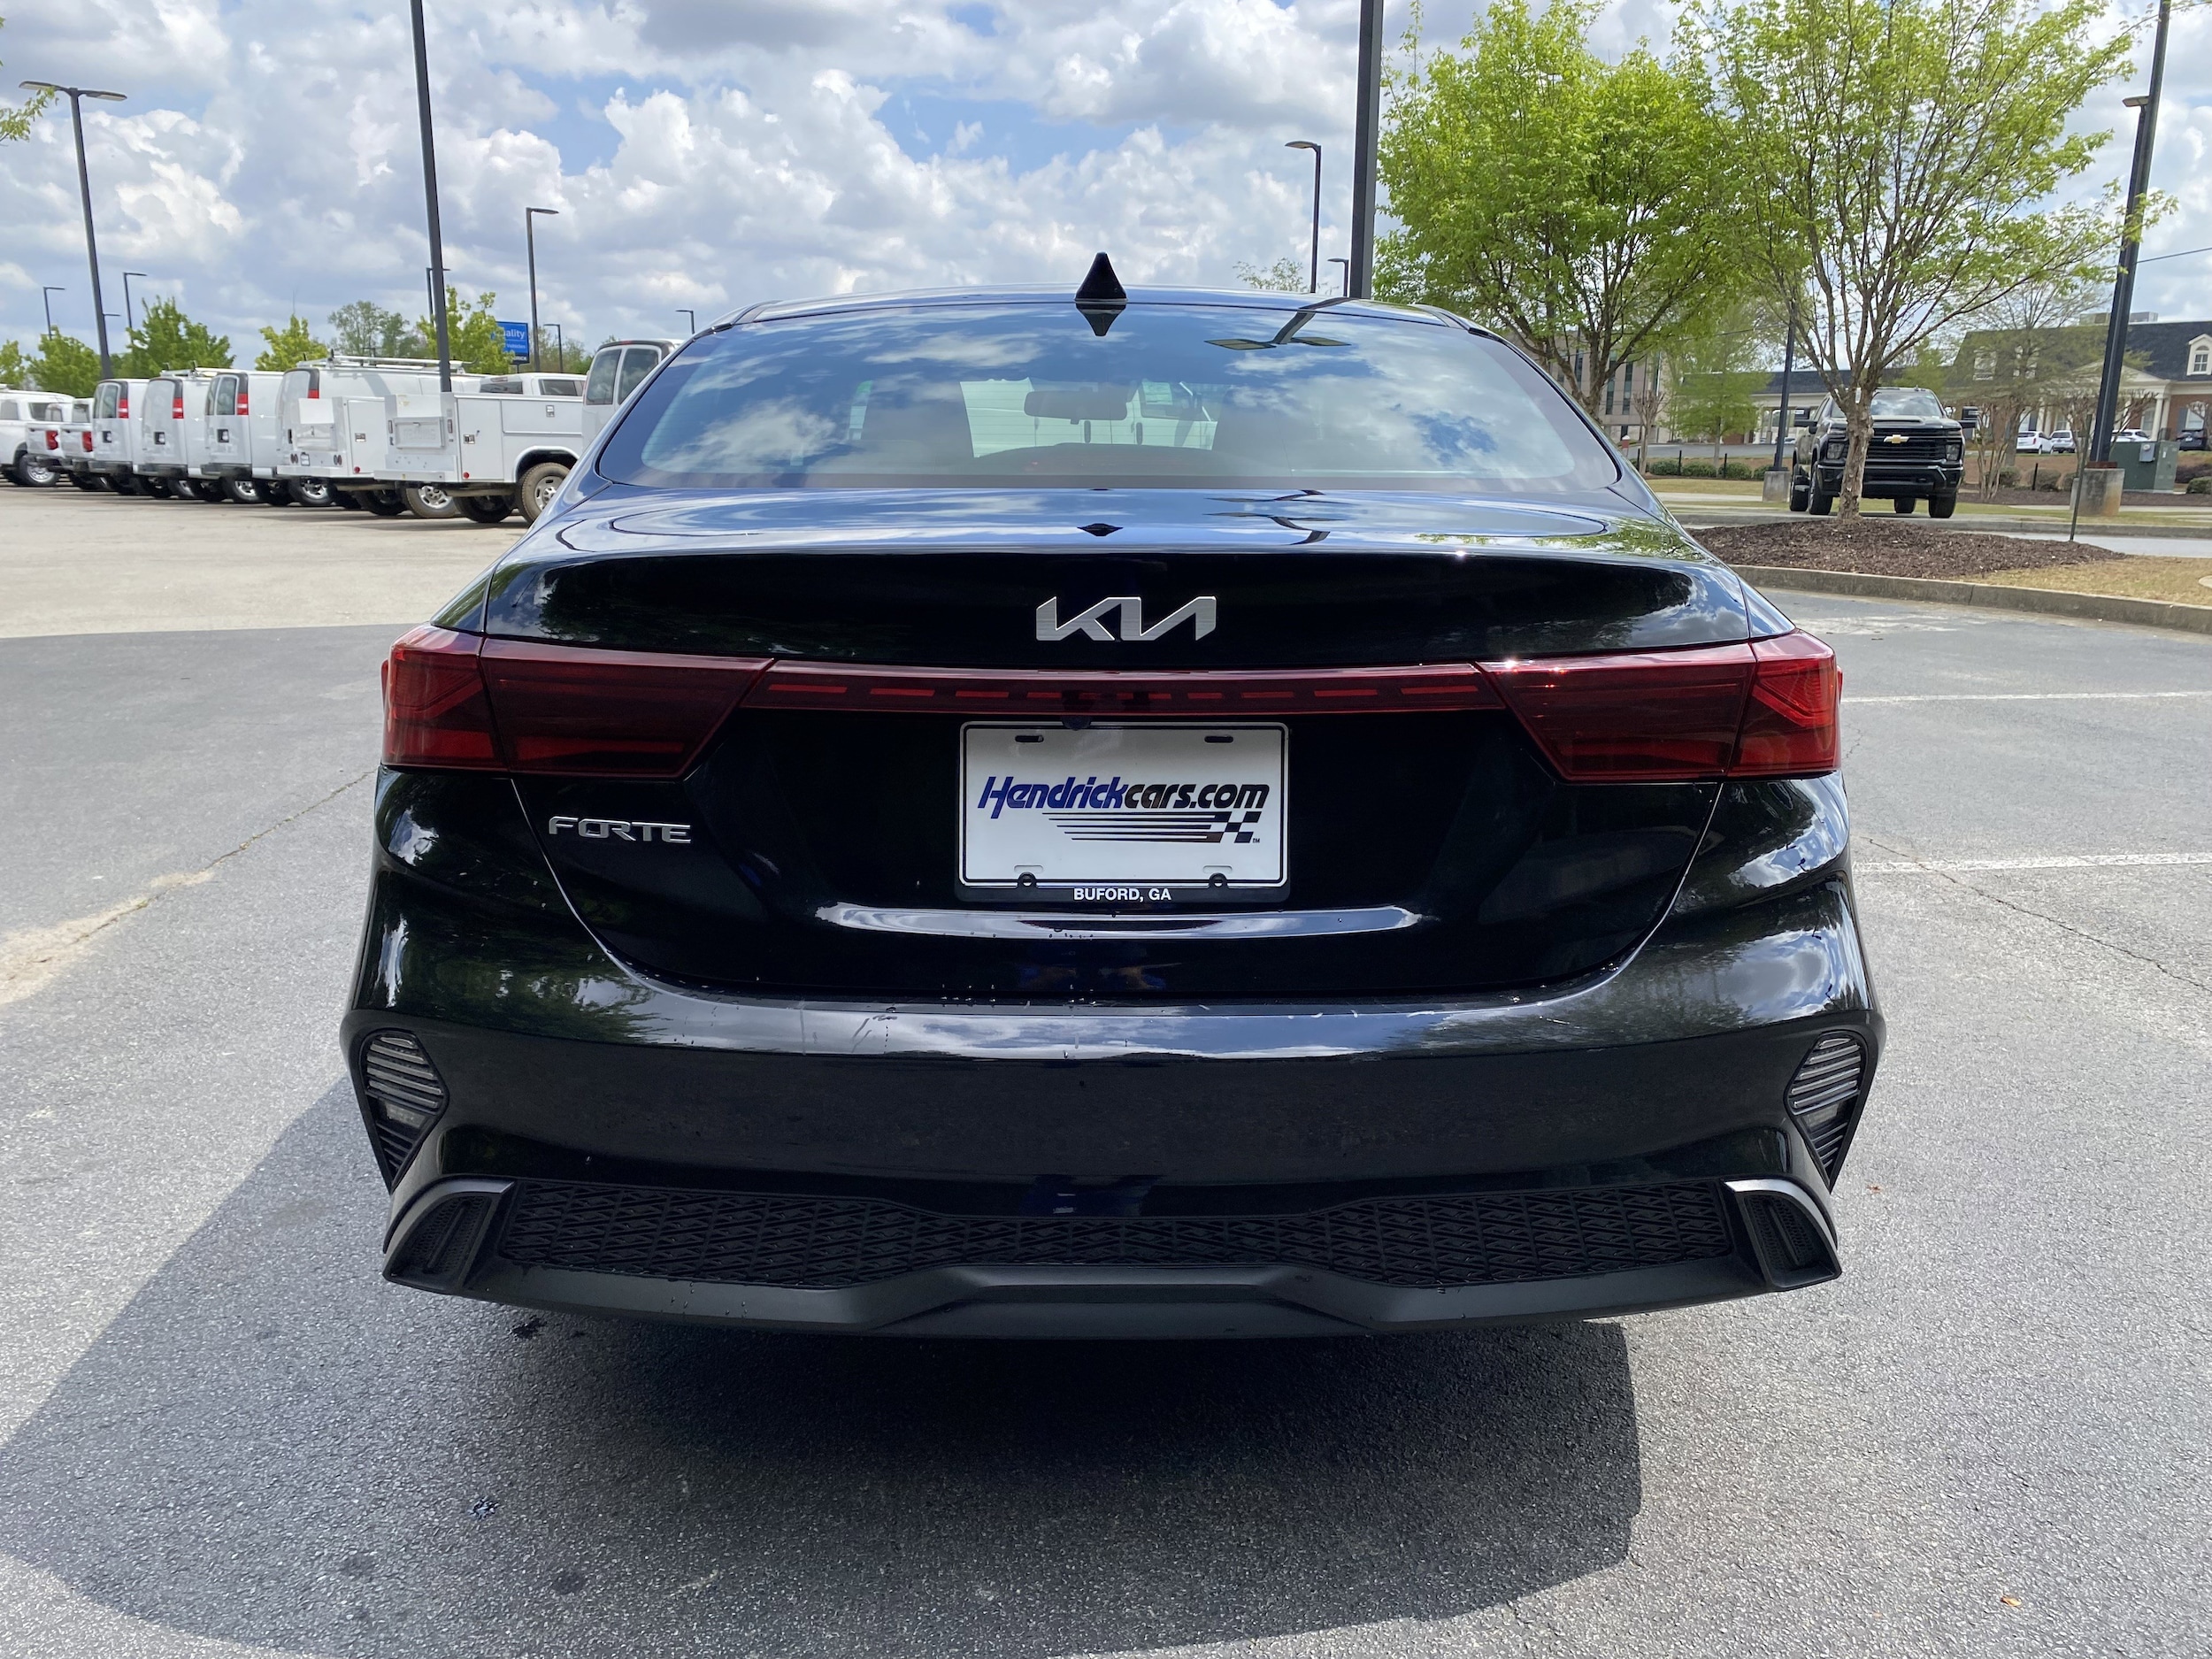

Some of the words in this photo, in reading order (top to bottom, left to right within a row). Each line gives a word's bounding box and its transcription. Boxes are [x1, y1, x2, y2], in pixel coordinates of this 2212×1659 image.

[978, 776, 1270, 818] Hendrickcars.com
[549, 816, 691, 843] FORTE
[1073, 887, 1144, 902] BUFORD,
[1148, 887, 1171, 901] GA
